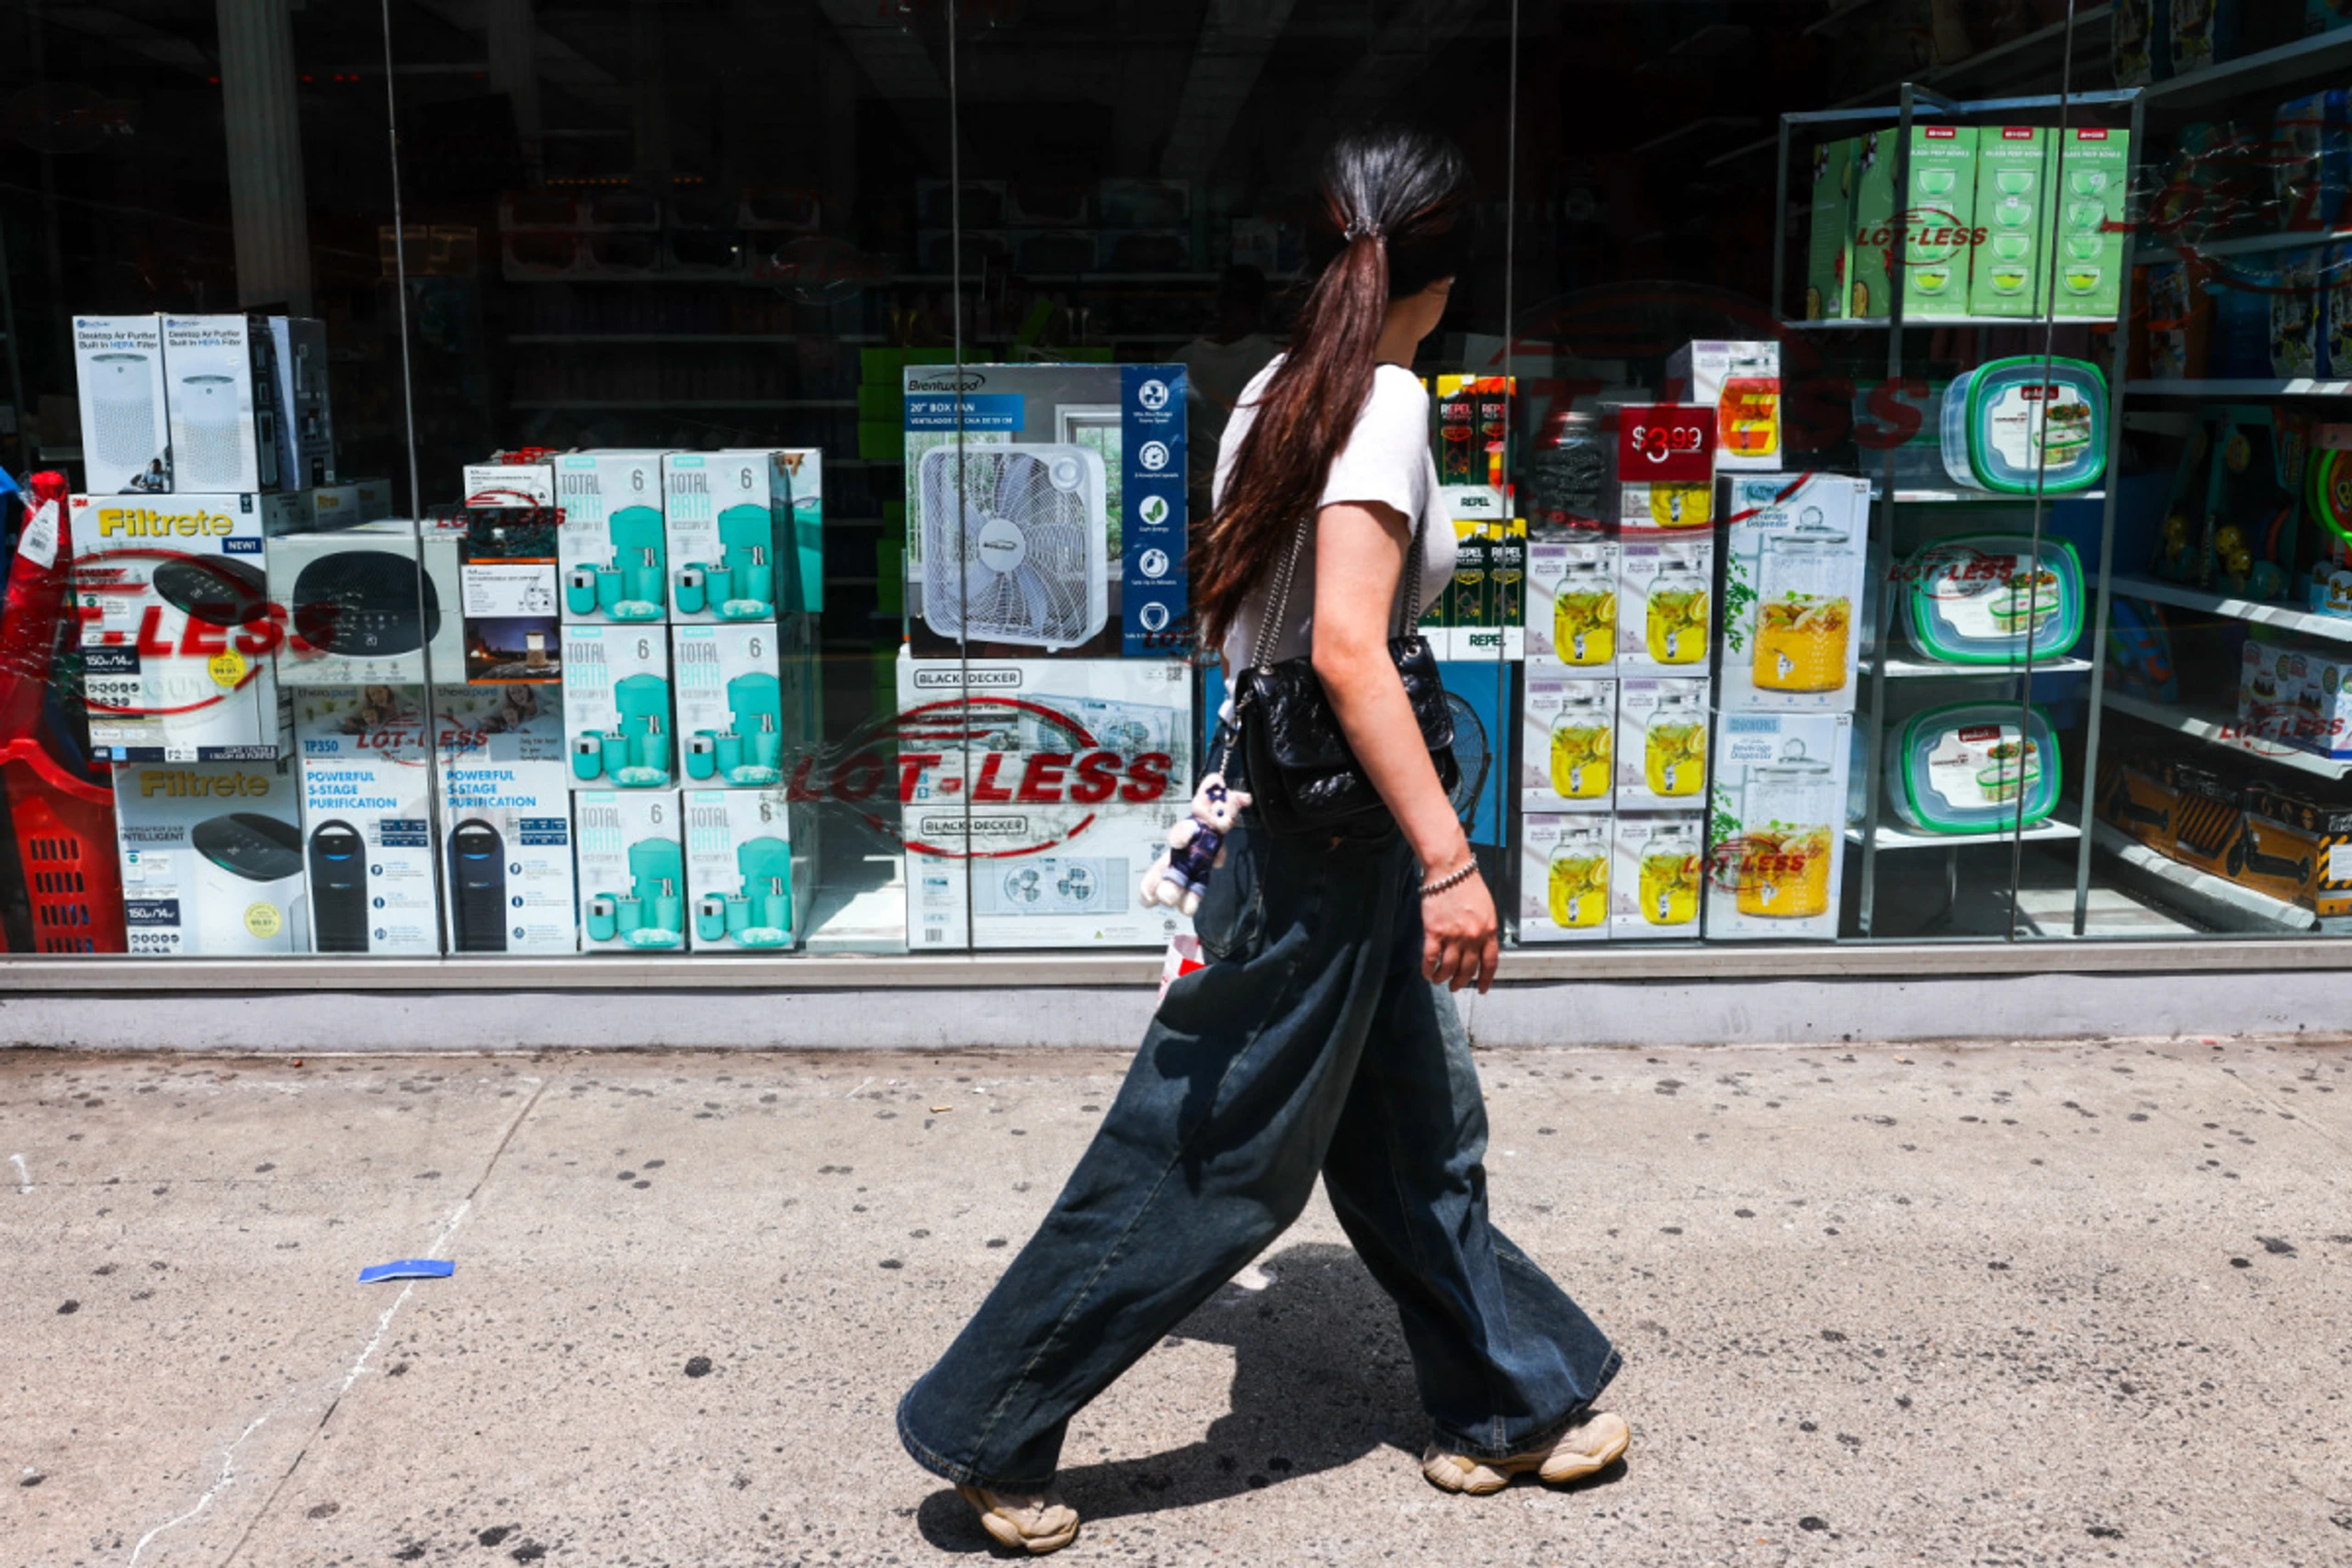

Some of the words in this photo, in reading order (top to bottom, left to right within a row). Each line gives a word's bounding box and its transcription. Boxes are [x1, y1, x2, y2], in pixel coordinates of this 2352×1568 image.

[1855, 227, 1988, 247] LOT-LESS
[110, 341, 135, 349] HEPA
[909, 379, 979, 390] Brentwood
[930, 403, 952, 412] BOX
[1441, 403, 1472, 415] REPEL
[1482, 403, 1509, 415] REPE
[560, 474, 602, 495] TOTAL
[632, 469, 644, 491] 6
[669, 472, 711, 494] TOTAL
[741, 468, 752, 490] 6
[73, 498, 89, 508] 3M
[561, 495, 603, 519] BATH
[670, 494, 712, 519] BATH
[1461, 497, 1490, 507] REPEL
[97, 508, 233, 537] Filtrete
[229, 541, 256, 550] NEW!
[1887, 563, 2013, 582] LOT-LESS
[637, 638, 650, 660] 6
[749, 637, 761, 659] 6
[1469, 635, 1506, 647] REPE
[567, 643, 606, 663] TOTAL
[680, 642, 719, 663] TOTAL
[568, 664, 608, 687] BATH
[680, 663, 721, 687] BATH
[920, 673, 1017, 683] BLACKDECKER
[2220, 717, 2346, 739] LOT-LESS
[167, 750, 181, 760] F2
[304, 740, 339, 752] TP350
[141, 771, 270, 797] Filtrete
[307, 772, 375, 783] POWERFUL
[447, 770, 515, 781] POWERFUL
[786, 751, 1173, 804] LOT-LESS
[308, 784, 358, 795] 5-STAGE
[447, 784, 497, 795] 5-STAGE
[309, 797, 397, 809] PURIFICATION
[448, 796, 537, 808] PURIFICATION
[581, 807, 620, 828] TOTAL
[650, 804, 662, 825] 6
[691, 807, 730, 828] TOTAL
[121, 833, 184, 841] INTELLIGENT
[582, 828, 621, 851] BATH
[691, 828, 731, 851] BATH
[1682, 854, 1806, 874] LOT-LESS
